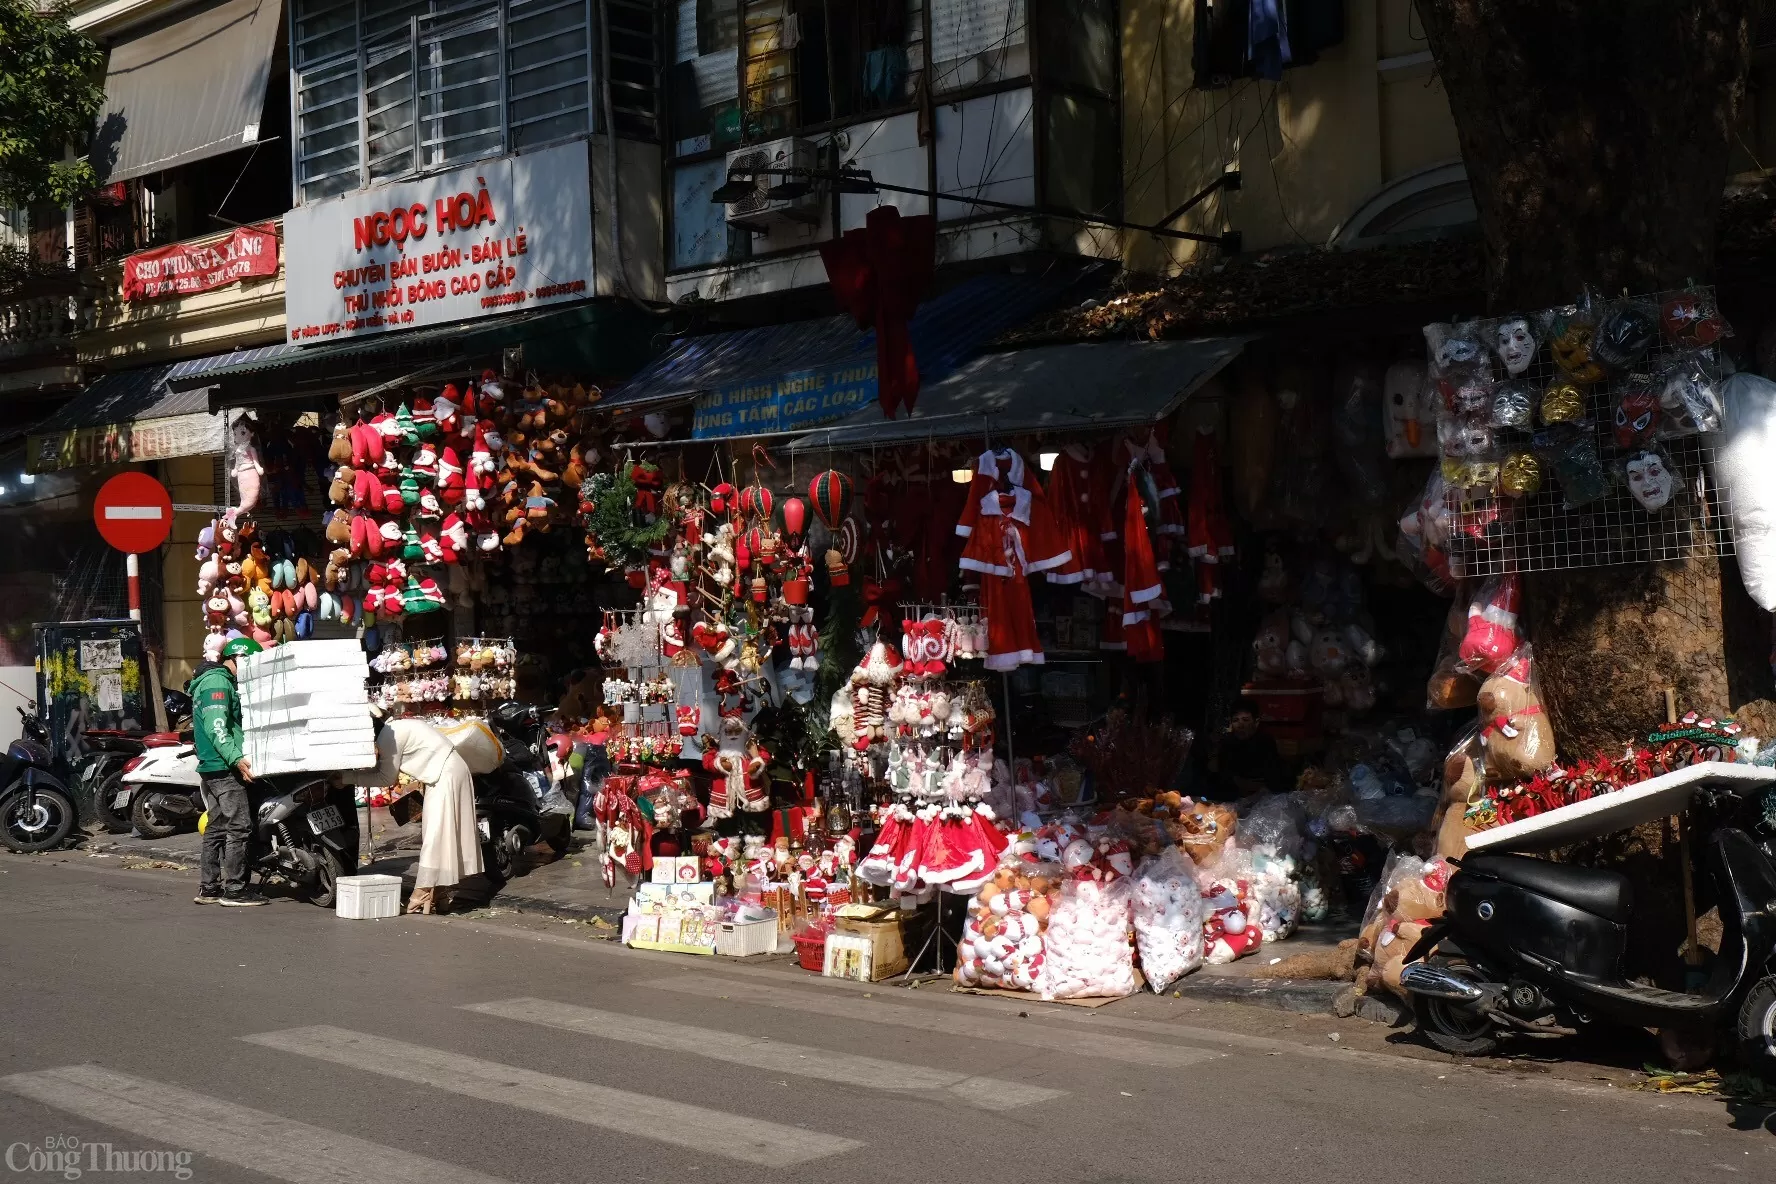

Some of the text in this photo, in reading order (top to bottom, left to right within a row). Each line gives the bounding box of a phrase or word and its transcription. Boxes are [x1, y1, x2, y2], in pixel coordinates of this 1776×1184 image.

[353, 176, 497, 252] NGỌC HOÀ
[136, 260, 160, 279] CHO
[334, 258, 386, 289] CHUYÊN
[390, 253, 418, 279] BÁN
[422, 244, 461, 274] BUÔN
[471, 236, 502, 265] BÁN
[407, 279, 447, 304] BÔNG
[450, 272, 481, 296] CAO
[485, 259, 516, 289] CẤP
